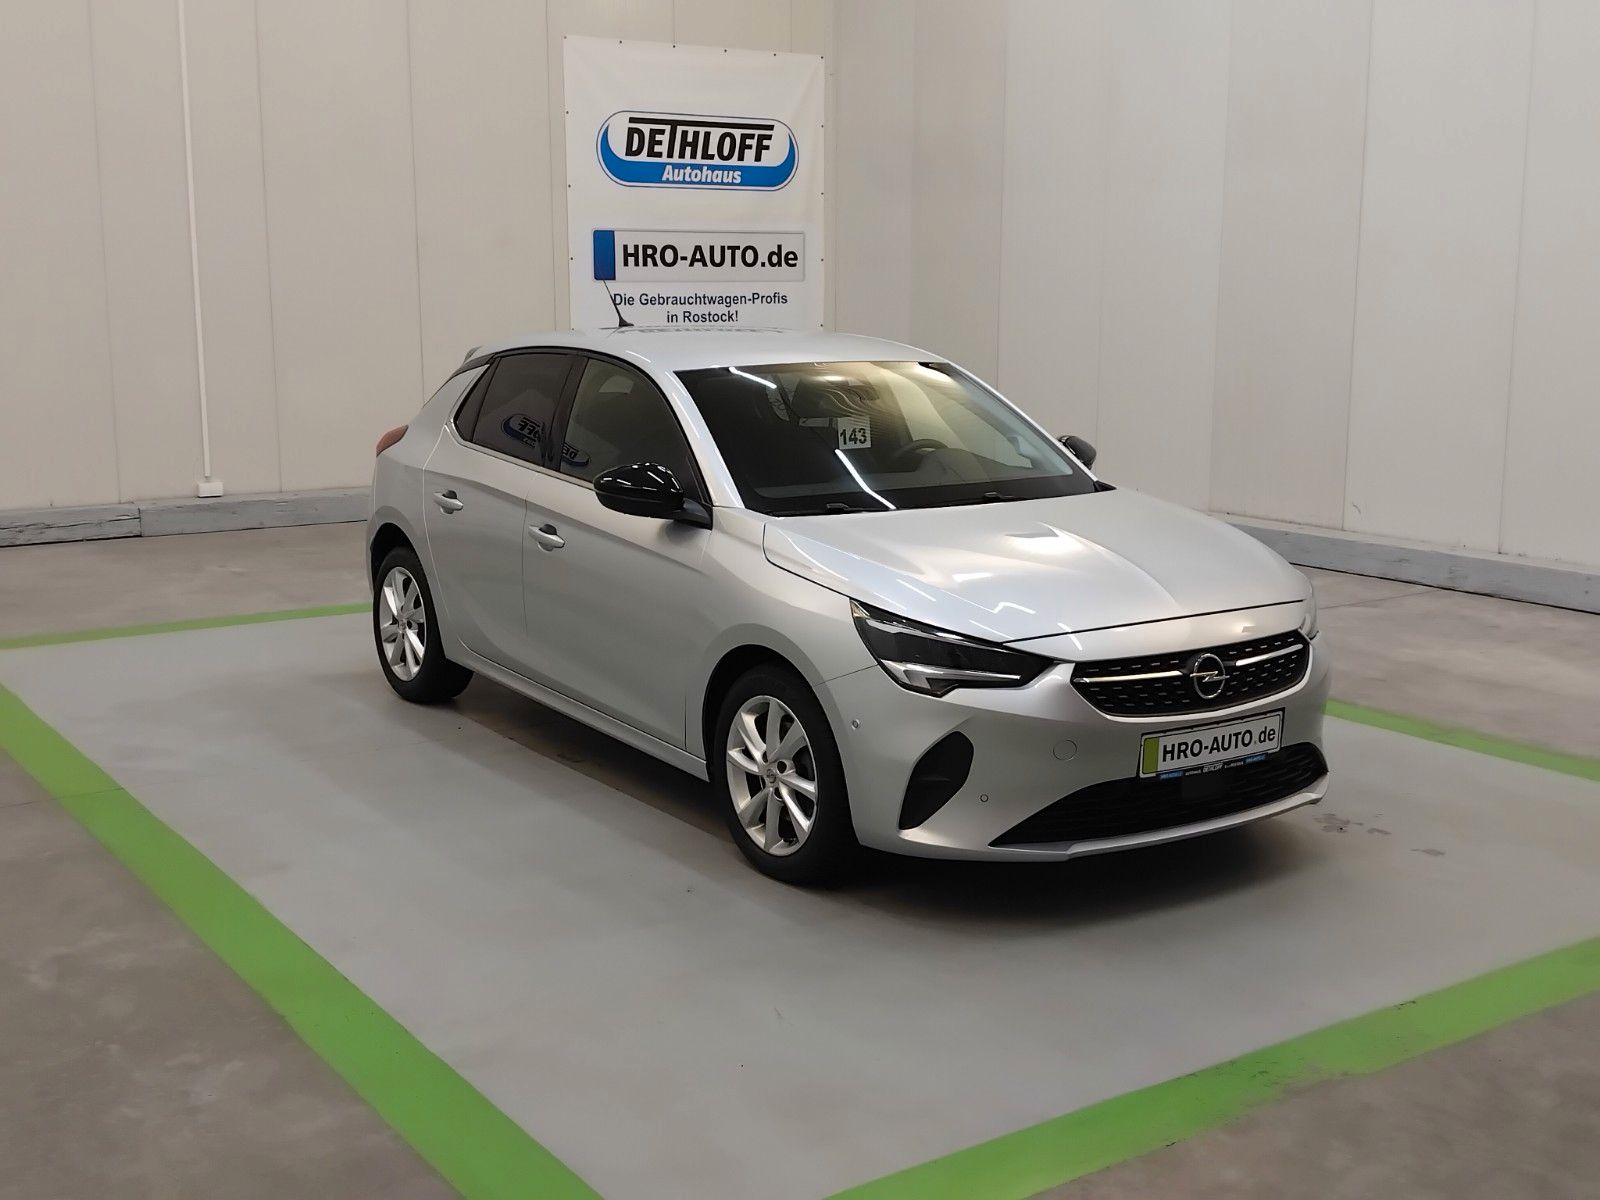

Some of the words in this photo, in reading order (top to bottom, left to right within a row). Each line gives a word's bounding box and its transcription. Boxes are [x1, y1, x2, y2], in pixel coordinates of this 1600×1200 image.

[625, 117, 775, 162] DETHLOFF
[662, 165, 742, 184] Autohaus
[622, 244, 799, 268] HRO-AUTO.de
[613, 293, 635, 306] Die
[639, 292, 788, 307] Gebrauchtwagen-Profis
[666, 311, 679, 323] in
[683, 310, 739, 323] Rostock!
[839, 427, 867, 445] 143
